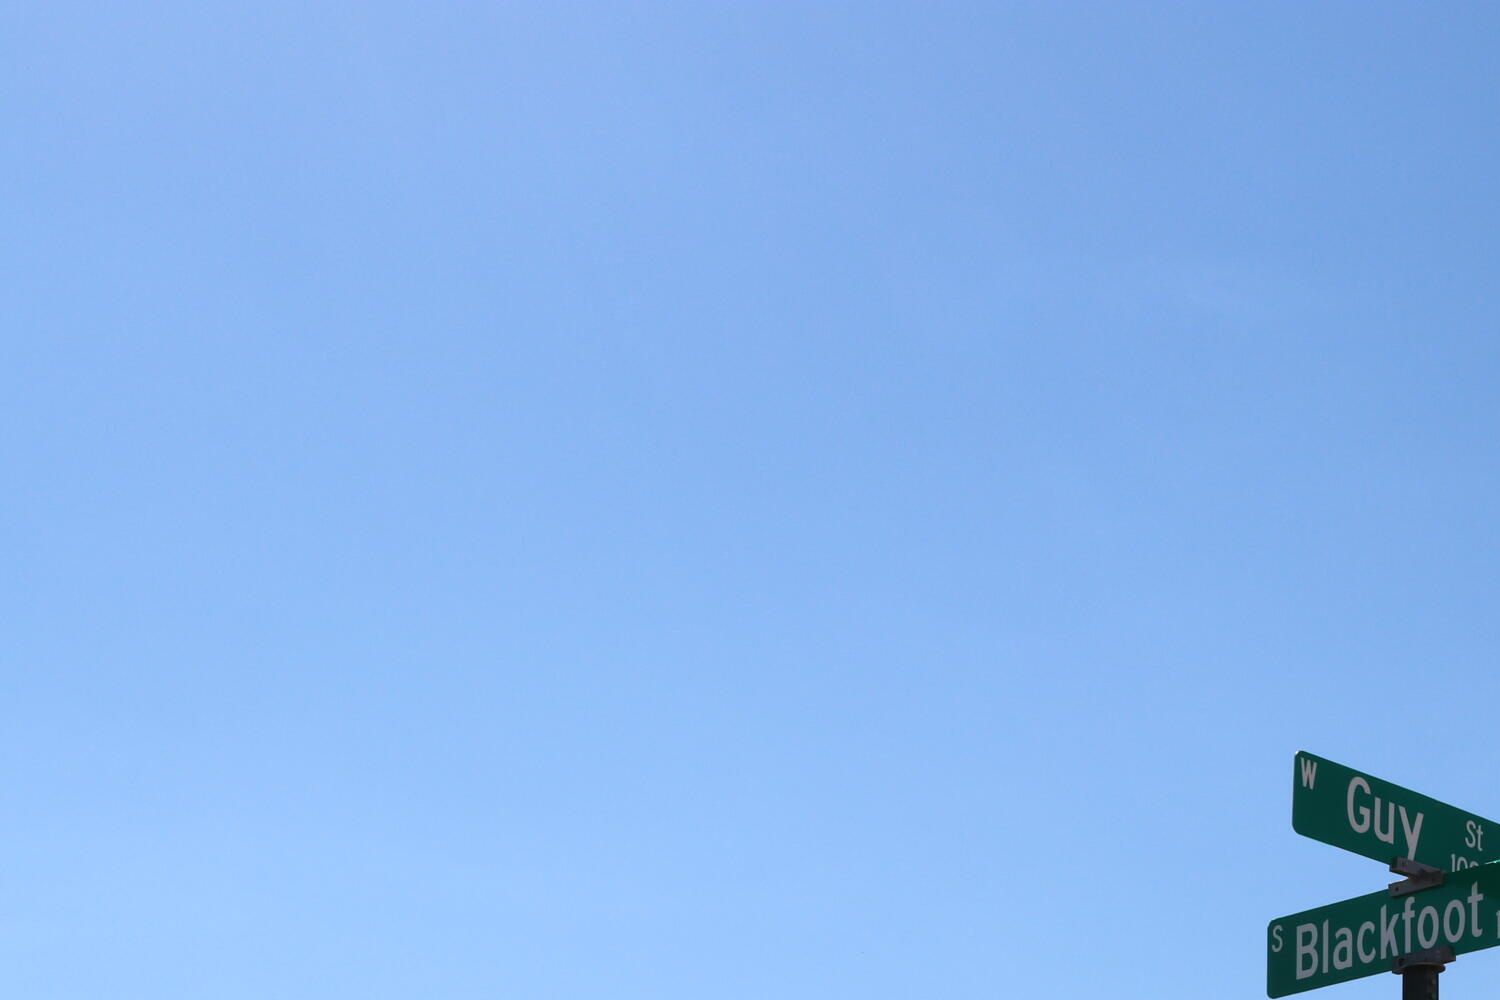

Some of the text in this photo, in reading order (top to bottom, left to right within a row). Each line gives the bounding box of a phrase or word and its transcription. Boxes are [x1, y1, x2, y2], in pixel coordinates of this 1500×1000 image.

[1301, 757, 1483, 861] W Guy St
[1272, 925, 1284, 952] S
[1296, 881, 1484, 980] Blackfoot
